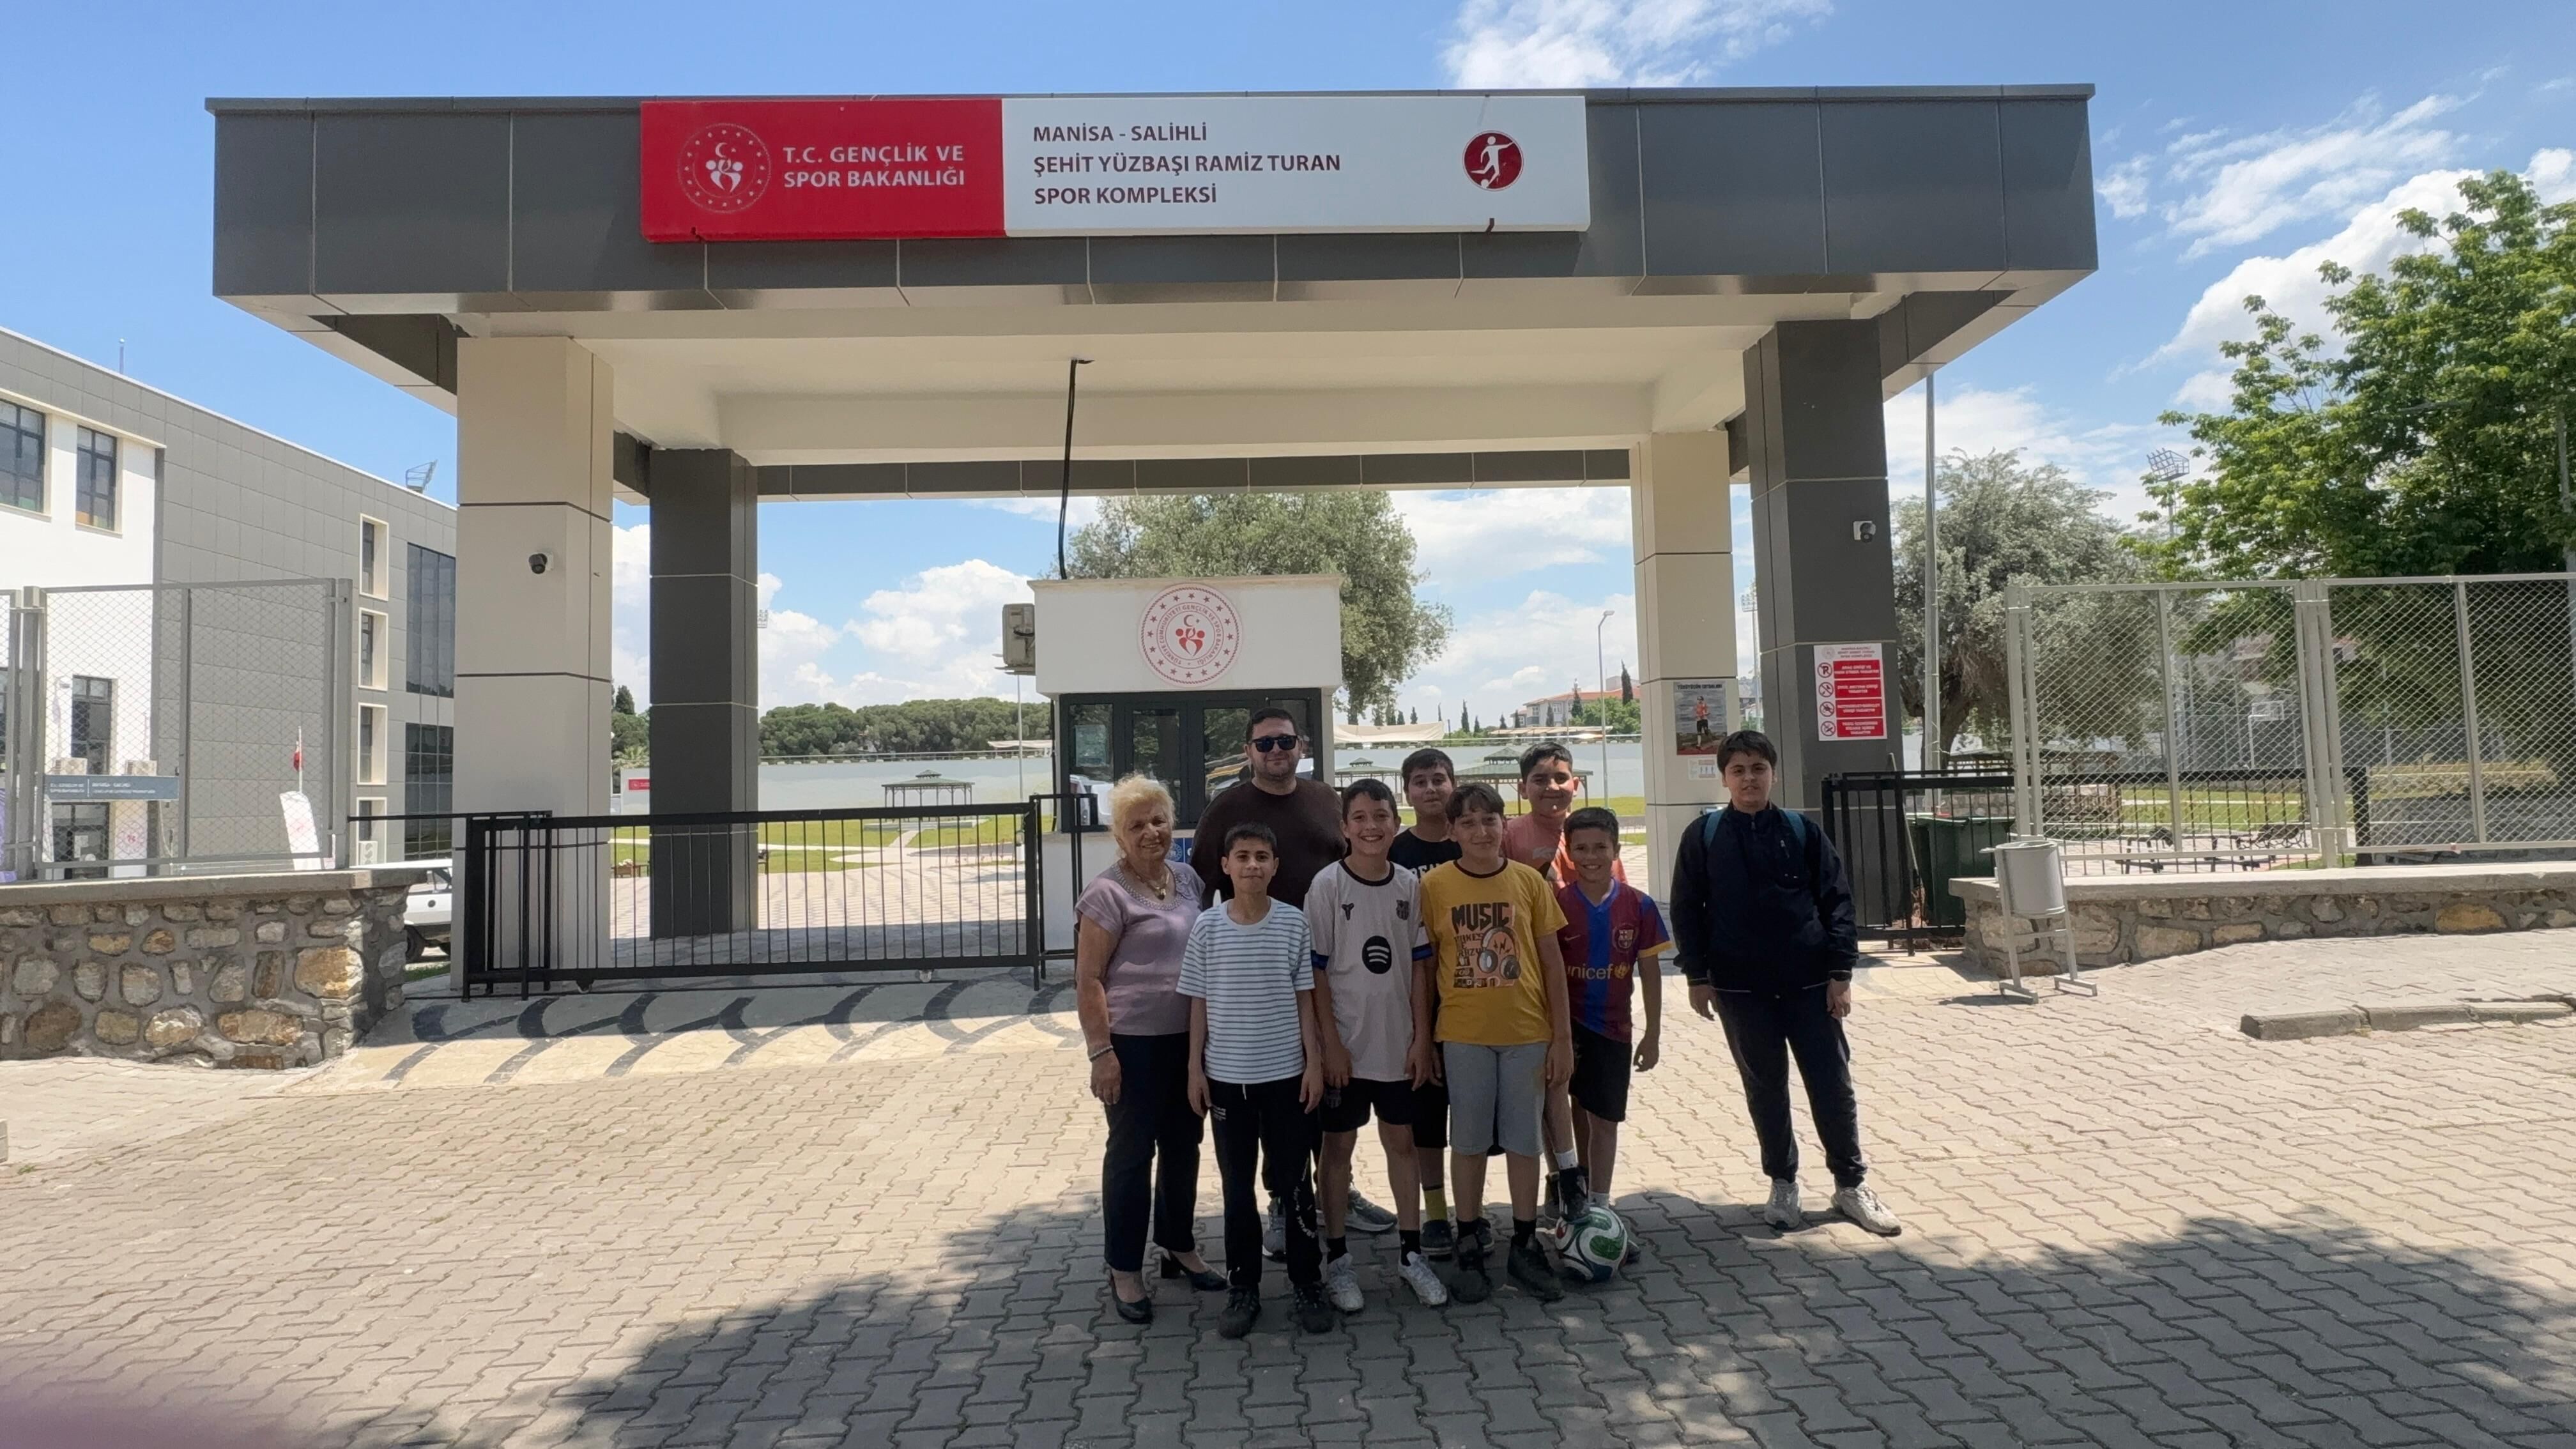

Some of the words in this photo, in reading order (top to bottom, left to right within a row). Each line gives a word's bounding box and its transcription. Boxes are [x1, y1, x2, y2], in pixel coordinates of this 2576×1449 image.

[1033, 123, 1114, 142] MANİSA
[1131, 122, 1207, 141] SALİHLİ
[783, 146, 823, 164] T.C.
[830, 142, 928, 167] GENÇLİK
[936, 144, 964, 162] VE
[1034, 152, 1094, 178] ŞEHİT
[1098, 151, 1189, 176] YÜZBAŞI
[1195, 151, 1264, 172] RAMİZ
[1267, 155, 1341, 172] TURAN
[784, 170, 841, 188] SPOR
[847, 165, 965, 187] BAKANLIĞI
[1034, 187, 1091, 204] SPOR
[1096, 183, 1217, 204] KOMPLEKSİ
[1182, 604, 1209, 613] GENÇLİK
[1208, 612, 1215, 621] VE
[1213, 620, 1222, 637] SPOR
[1451, 901, 1510, 935] MUSIC
